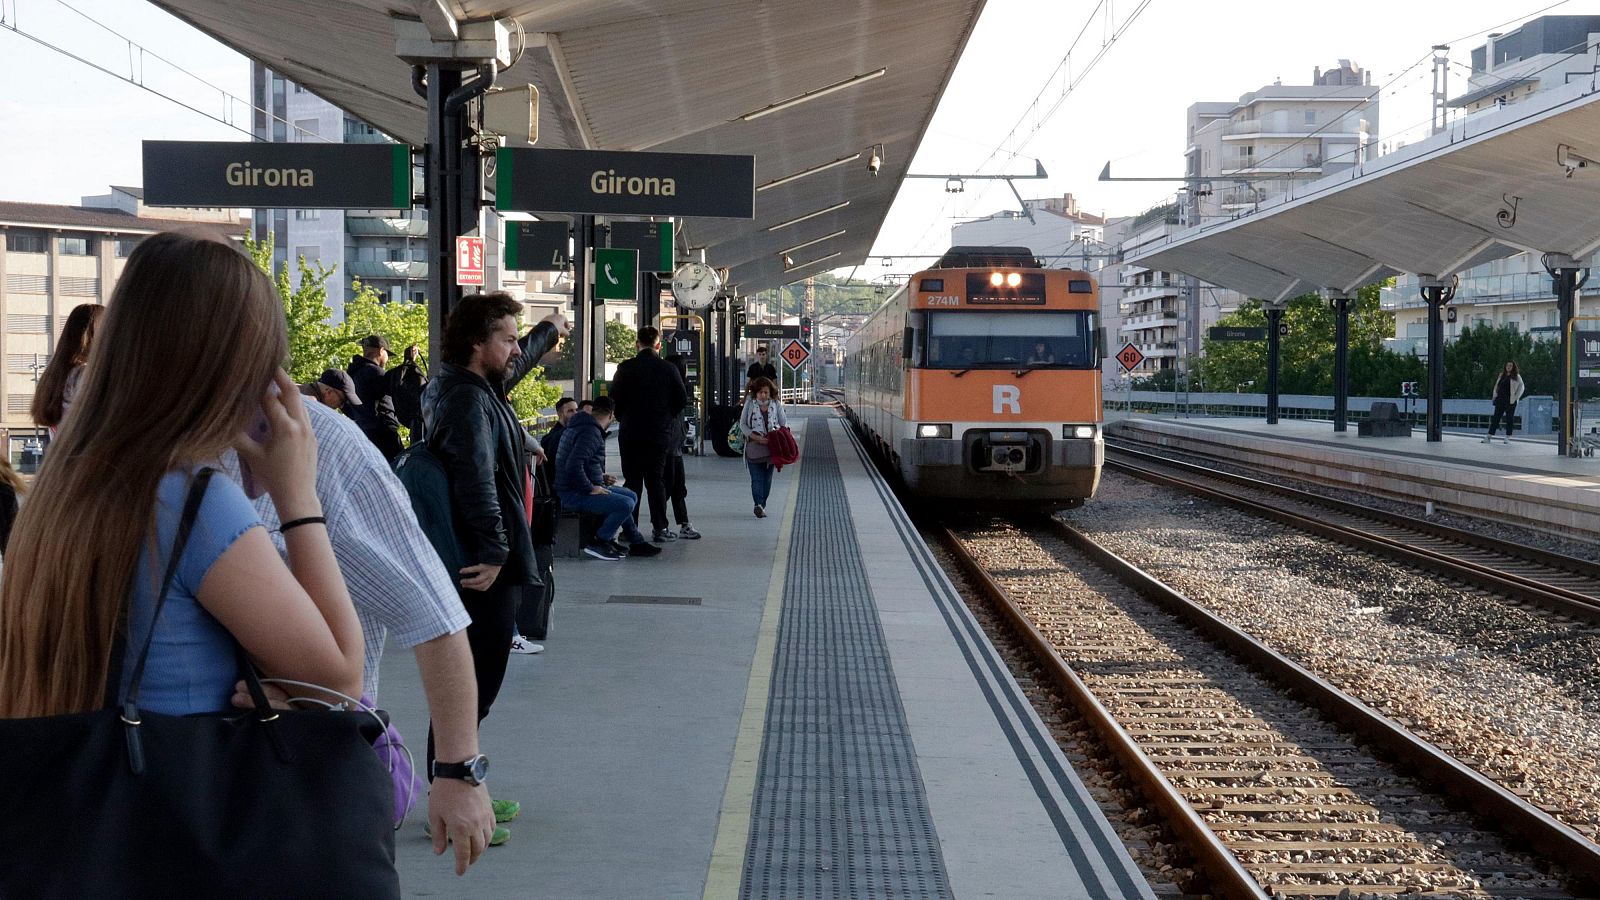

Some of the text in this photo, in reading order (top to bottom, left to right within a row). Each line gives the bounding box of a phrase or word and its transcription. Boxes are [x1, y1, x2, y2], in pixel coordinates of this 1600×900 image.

[226, 161, 314, 186] Girona
[591, 169, 676, 196] Girona
[552, 249, 566, 270] 4
[927, 295, 959, 306] 274M
[788, 349, 801, 360] 60
[1123, 352, 1136, 362] 60
[992, 384, 1021, 414] R
